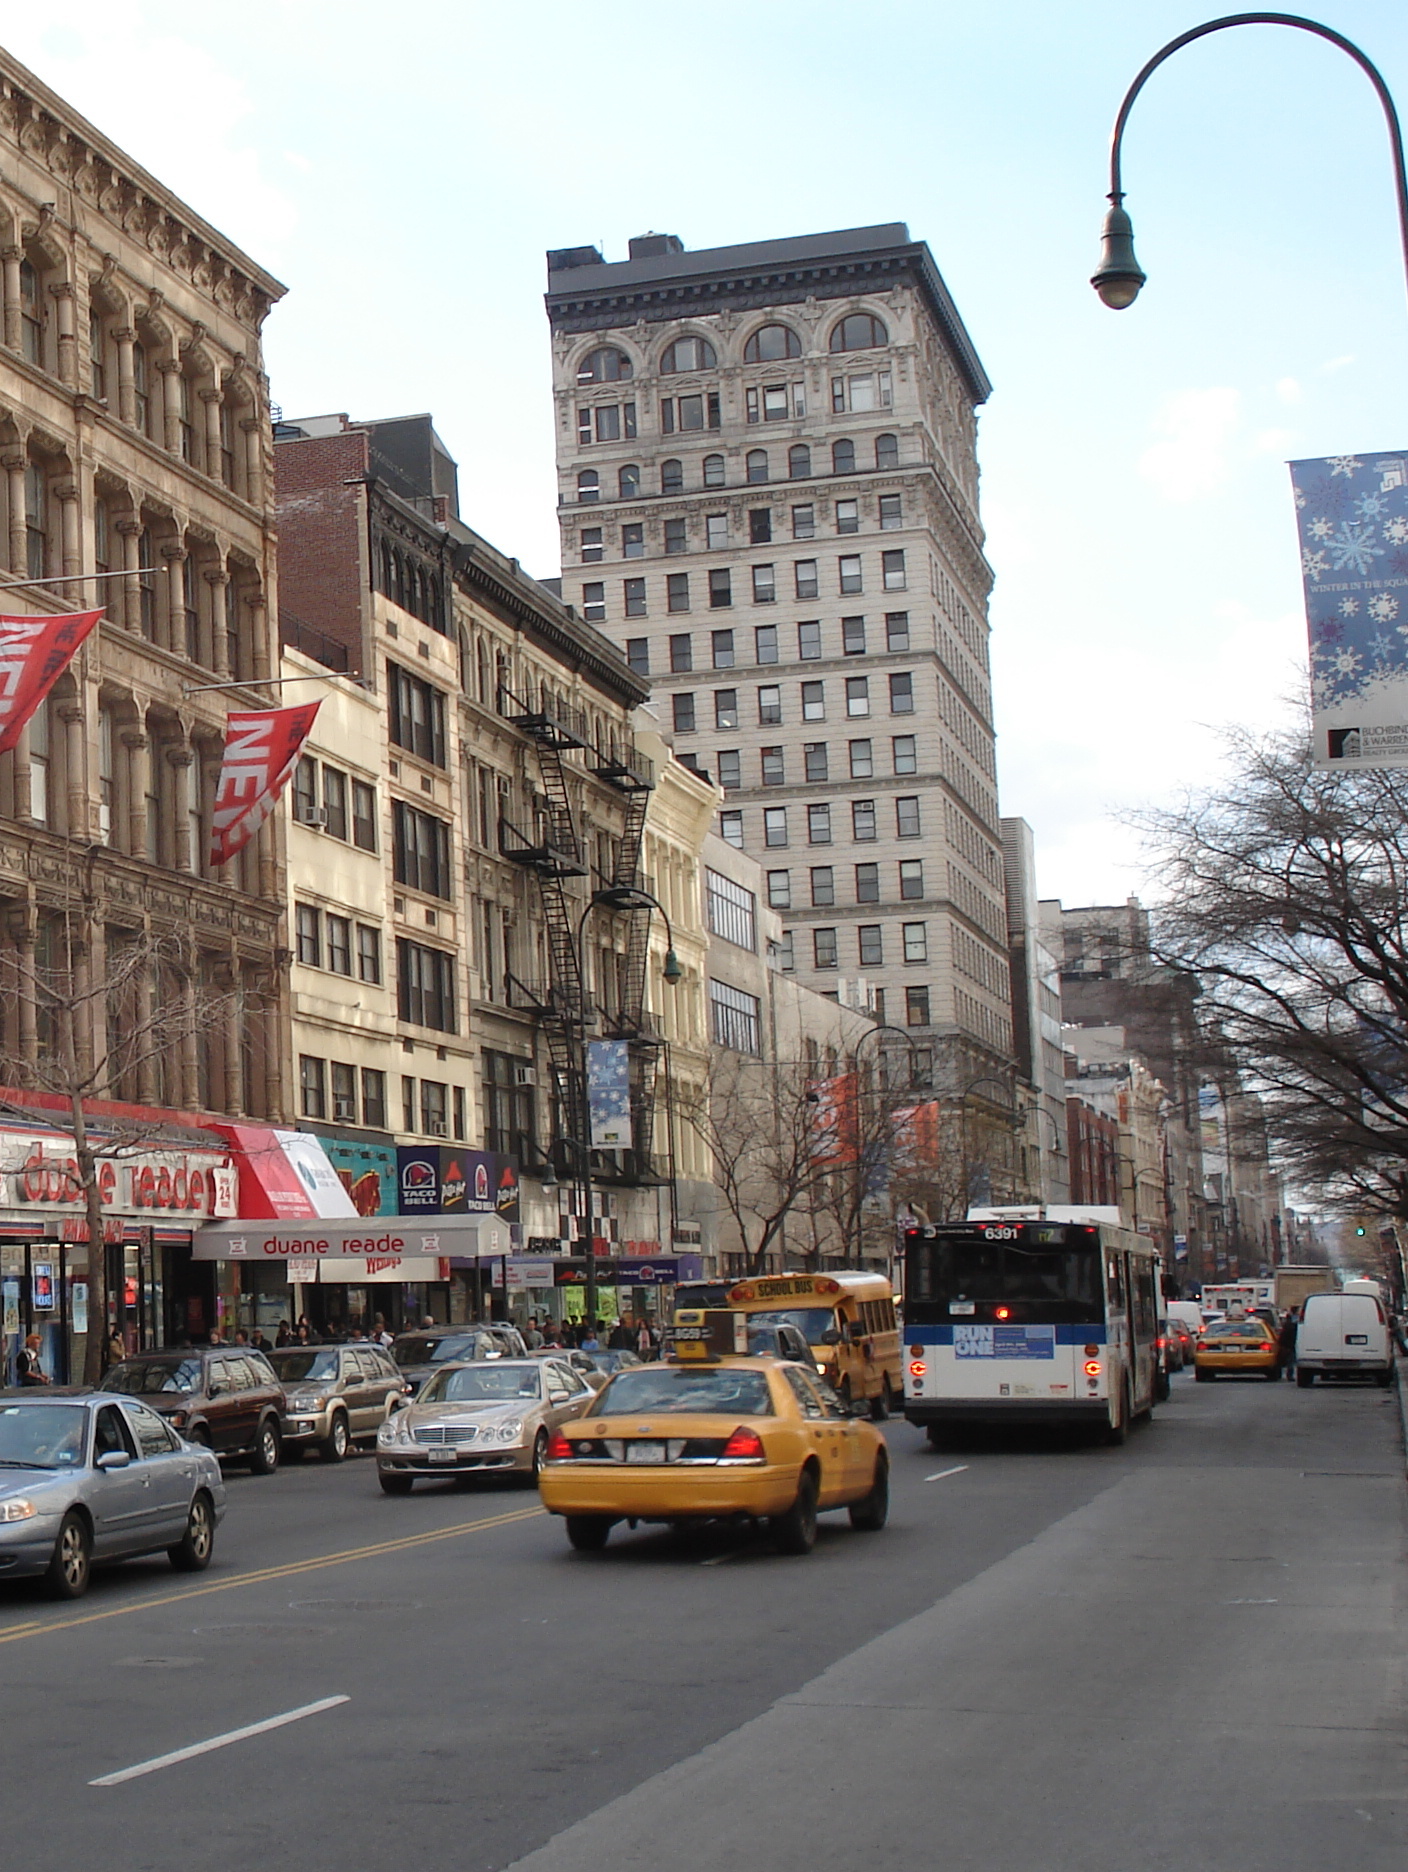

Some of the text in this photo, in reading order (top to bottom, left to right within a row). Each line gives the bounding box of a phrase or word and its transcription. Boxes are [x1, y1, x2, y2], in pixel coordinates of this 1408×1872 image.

[1310, 582, 1349, 593] WINTER
[1350, 581, 1361, 591] IN
[1362, 580, 1382, 590] THE
[132, 1155, 203, 1209] reade
[219, 1185, 231, 1201] 24
[404, 1197, 437, 1205] BELL
[985, 1228, 1017, 1239] 6391
[264, 1236, 329, 1254] duane
[343, 1234, 405, 1252] reade
[757, 1279, 813, 1296] SCHOOL BUS
[954, 1327, 992, 1340] RUN
[955, 1341, 994, 1355] ONE
